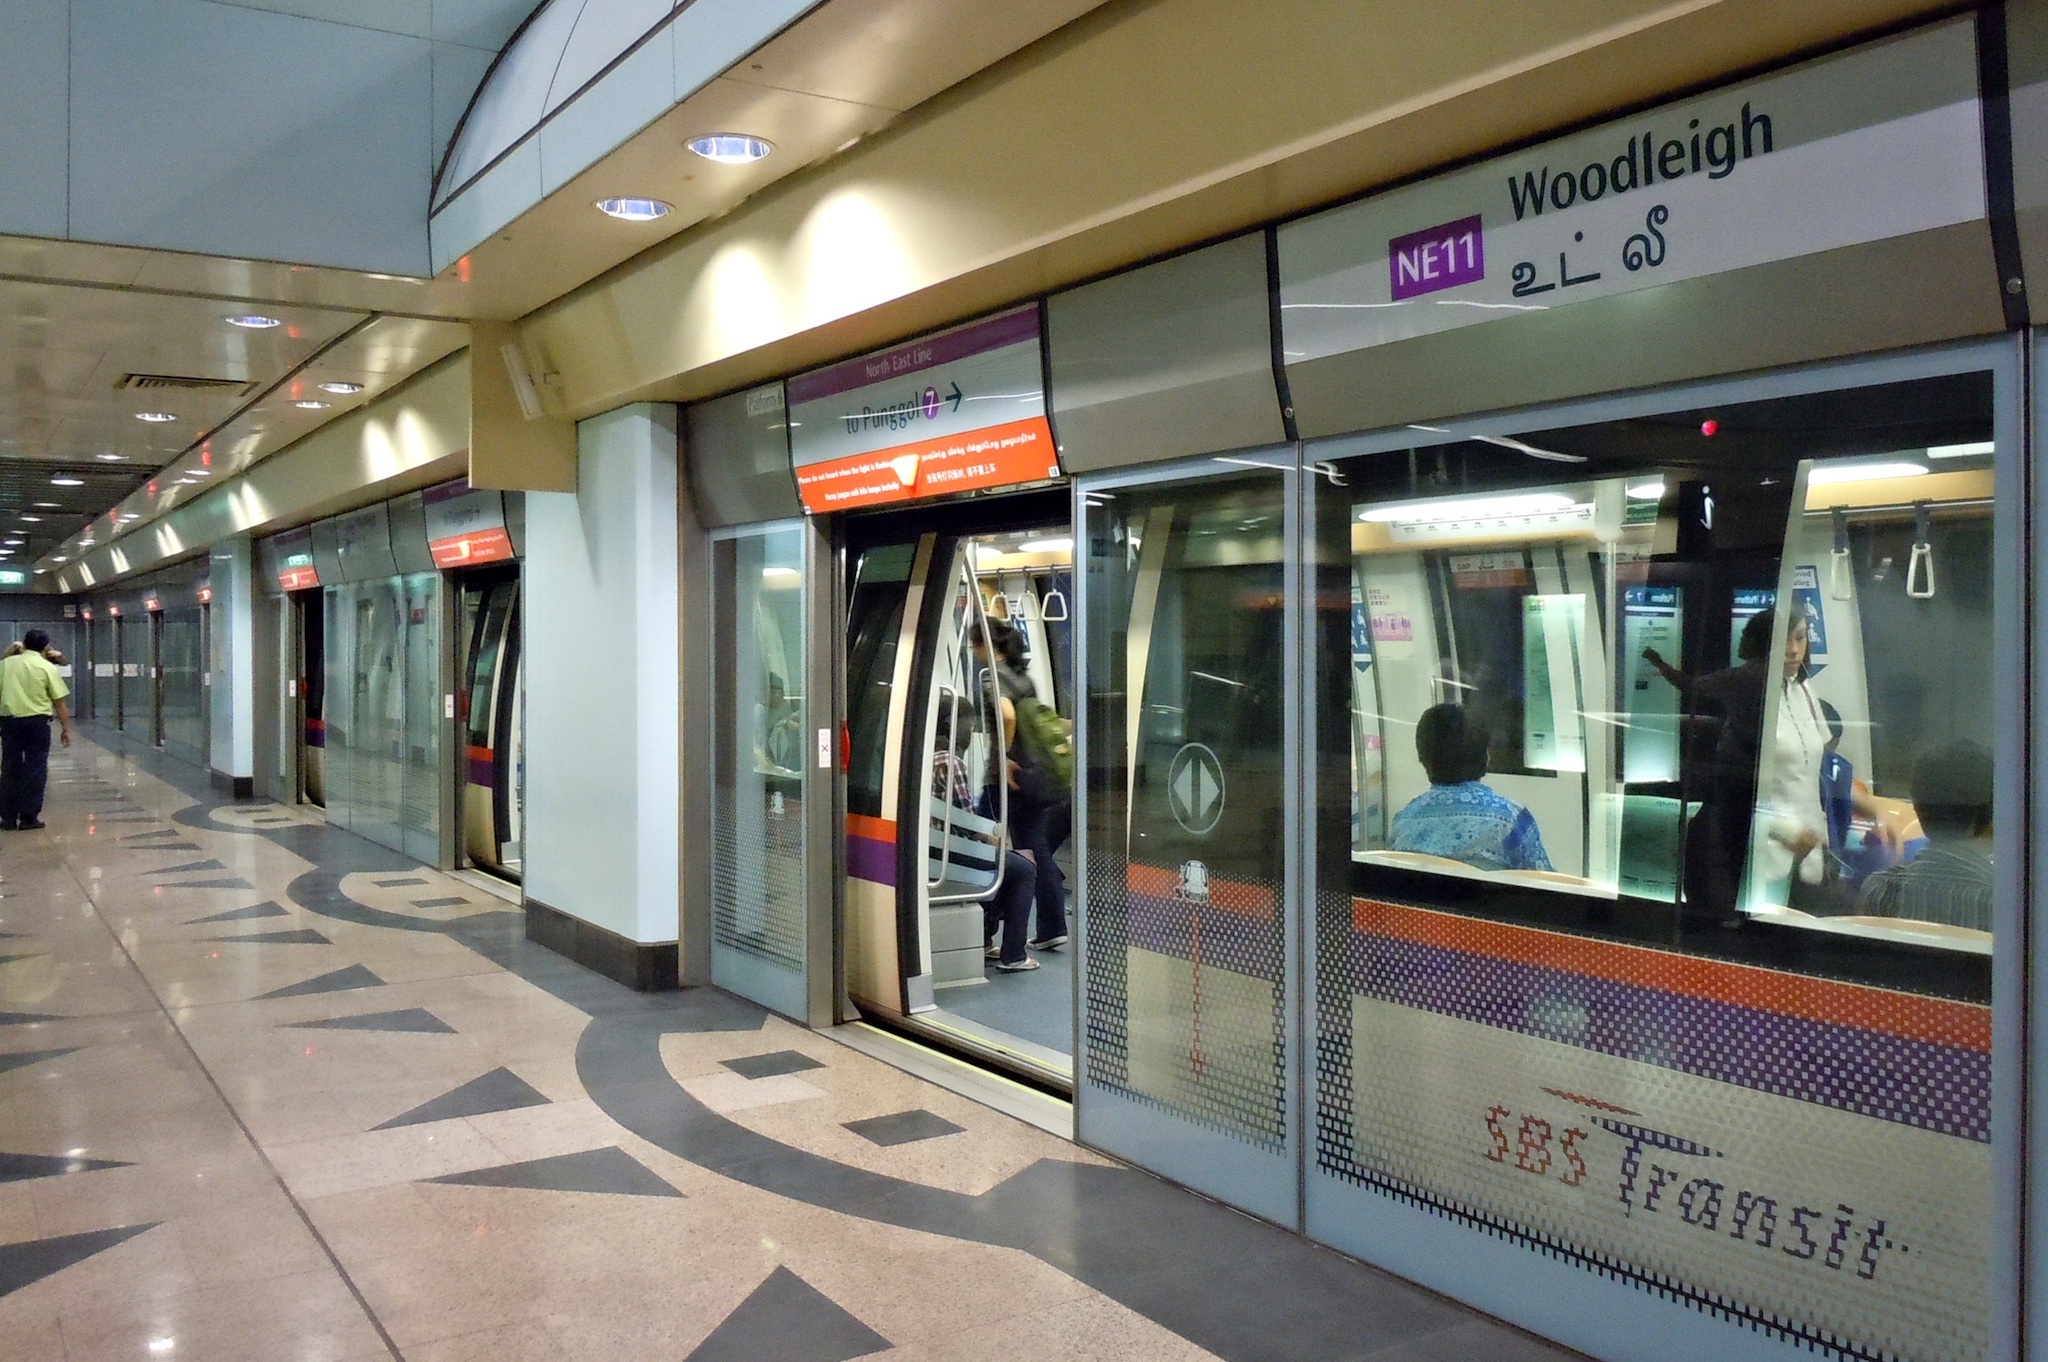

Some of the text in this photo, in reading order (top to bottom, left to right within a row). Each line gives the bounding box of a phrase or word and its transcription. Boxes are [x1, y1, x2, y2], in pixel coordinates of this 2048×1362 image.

[1508, 101, 1774, 221] Woodleigh
[1396, 232, 1475, 287] NE11
[866, 347, 932, 379] North East Line
[846, 390, 936, 435] to Punggol 7
[958, 544, 962, 552] 6
[1484, 1104, 1909, 1280] SBS Transit
